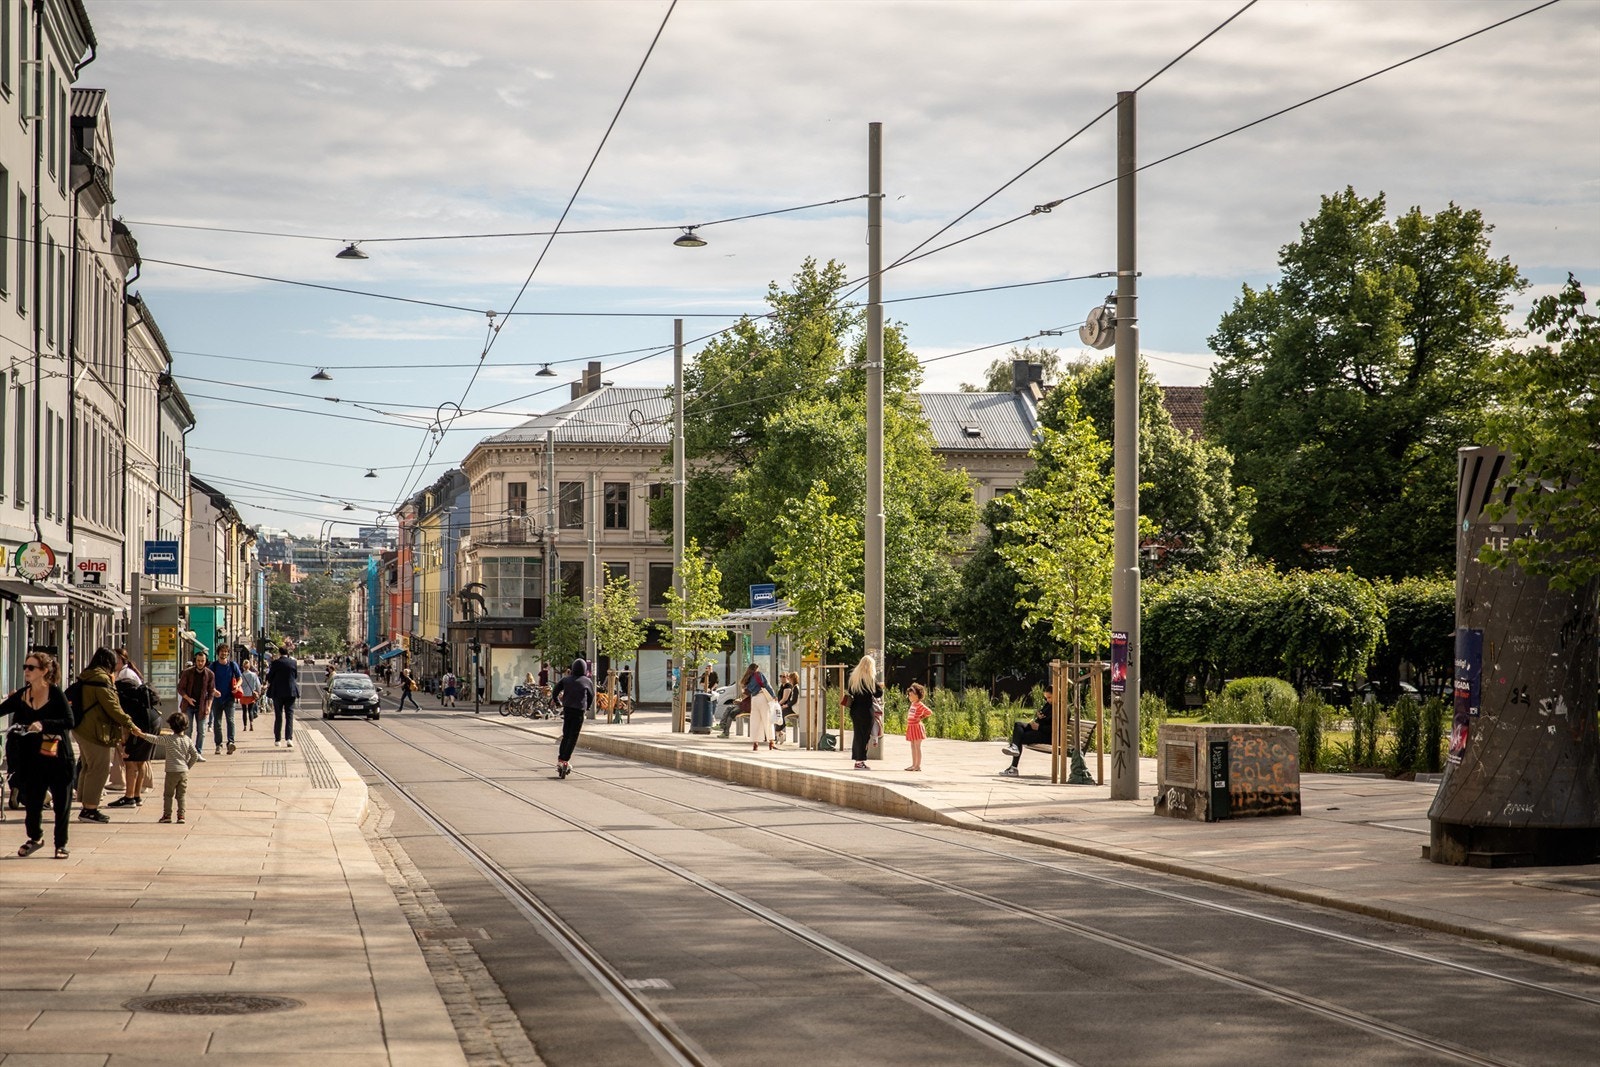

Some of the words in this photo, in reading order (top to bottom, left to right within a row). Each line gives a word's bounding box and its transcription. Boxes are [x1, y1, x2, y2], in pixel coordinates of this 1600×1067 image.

[24, 560, 46, 568] Palazzo
[78, 559, 107, 572] elna
[18, 565, 54, 580] PIZZERIA
